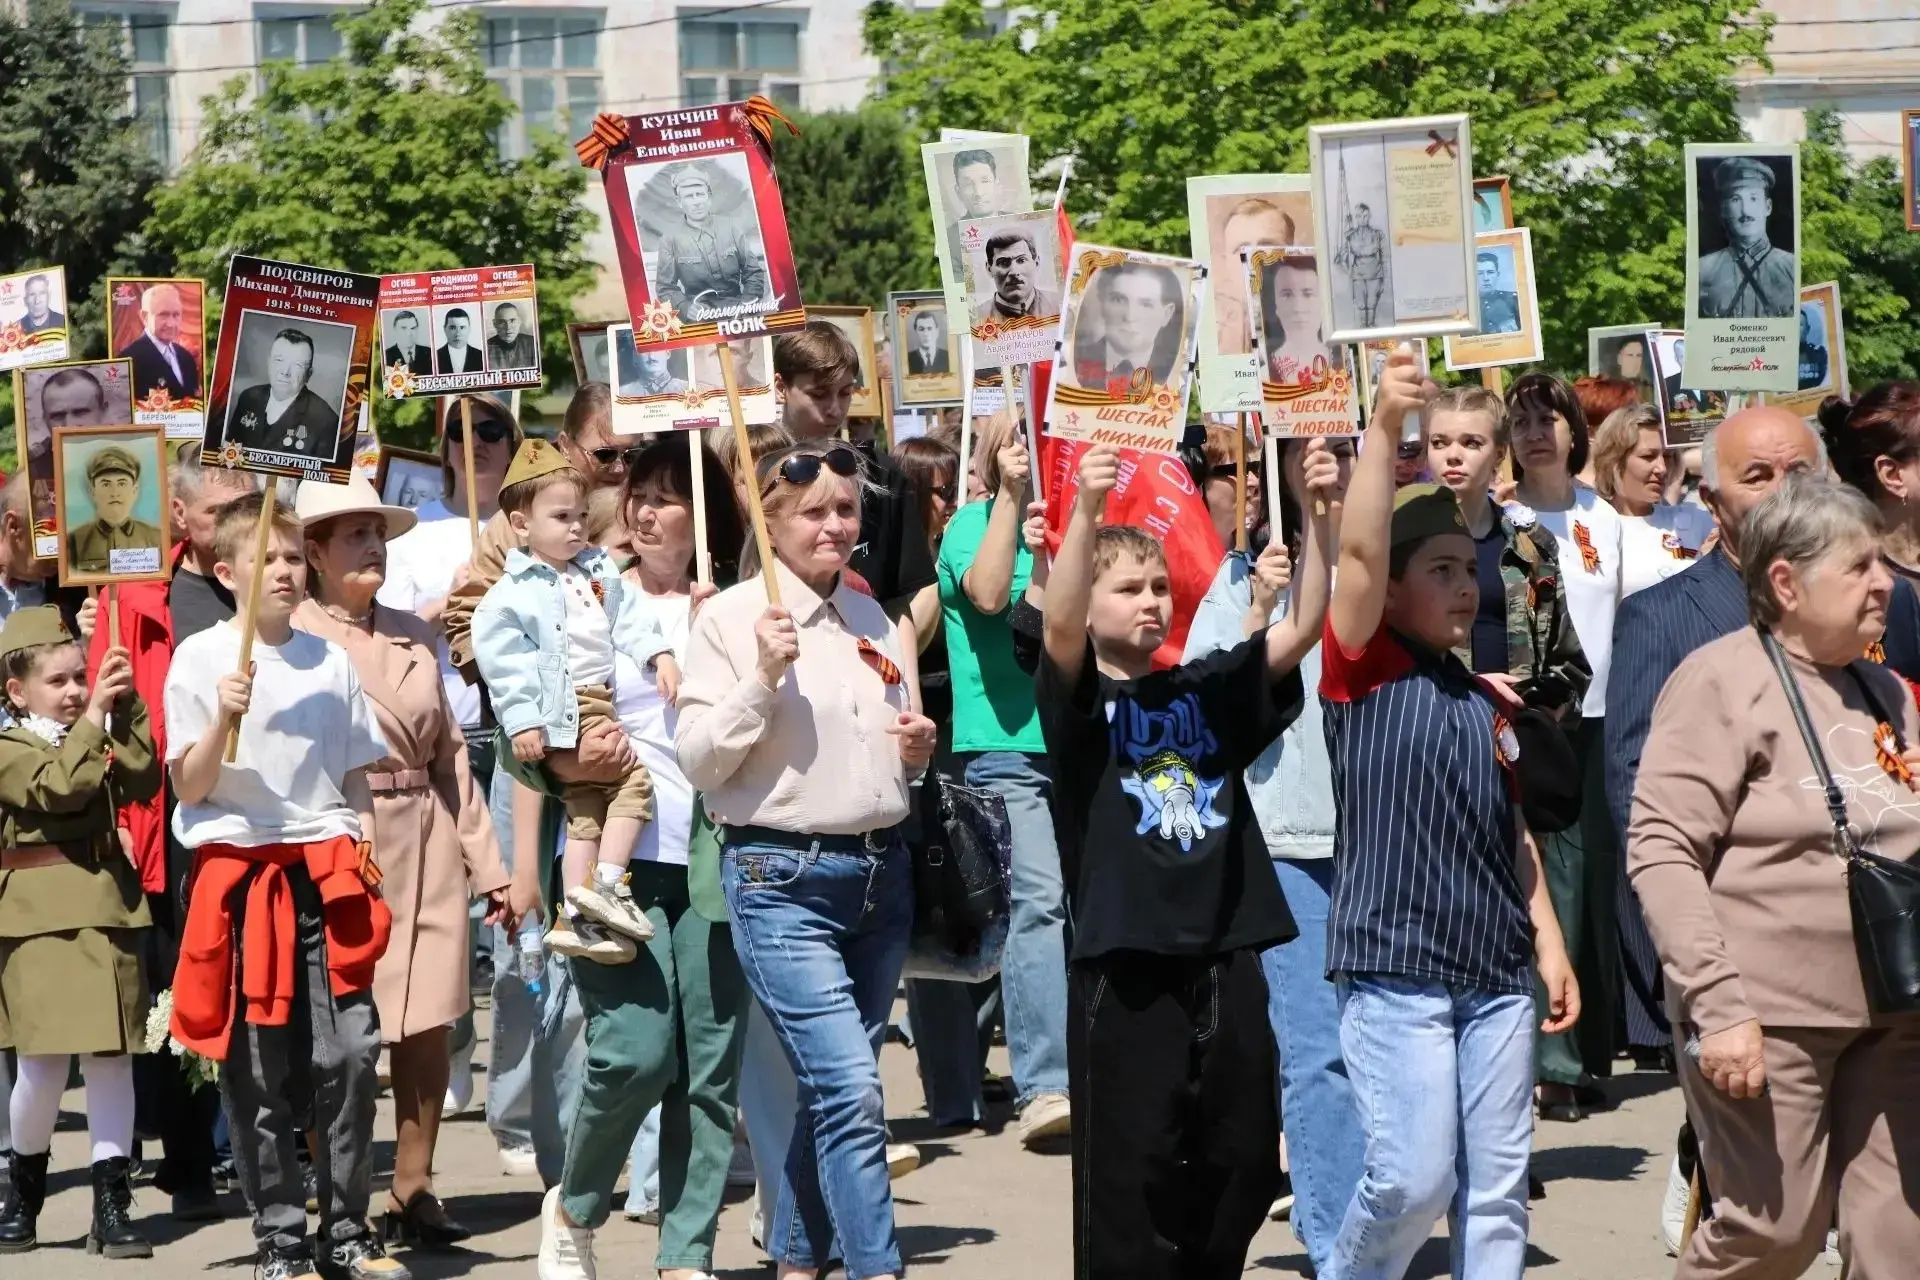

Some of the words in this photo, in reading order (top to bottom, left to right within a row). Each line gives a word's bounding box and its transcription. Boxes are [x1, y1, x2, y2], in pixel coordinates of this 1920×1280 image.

[641, 108, 719, 129] КУНЧИН
[660, 127, 702, 141] Иван
[636, 137, 735, 158] Епифанович
[260, 264, 354, 289] ПОДСВИРОВ
[430, 273, 478, 285] БРОДНИКОВ
[493, 270, 518, 280] ОГНЕВ
[391, 278, 416, 288] ОГНЕВ
[234, 275, 288, 295] Михаил
[291, 285, 374, 308] Дмитриевич
[265, 298, 322, 315] 1918-1988
[325, 309, 338, 318] гг.
[693, 289, 786, 321] бессмертный
[717, 316, 768, 336] ПОЛК
[1729, 324, 1768, 332] Фоменко
[999, 328, 1044, 341] МАРКАРОВ
[1713, 335, 1735, 343] Иван
[1737, 334, 1786, 343] Алексеевич
[986, 344, 1011, 354] Авдей
[1730, 345, 1766, 355] рядовой
[418, 370, 503, 390] БЕССМЕРТНЫЙ
[507, 369, 538, 383] ПОЛК
[1291, 399, 1349, 414] ШЕСТАК
[1096, 406, 1174, 430] ШЕСТАК
[1292, 420, 1354, 435] ЛЮБОВЬ
[1091, 428, 1174, 452] МИХАИЛ
[249, 451, 322, 471] БЕССМЕРТНЫЙ
[303, 469, 331, 482] ПОЛК
